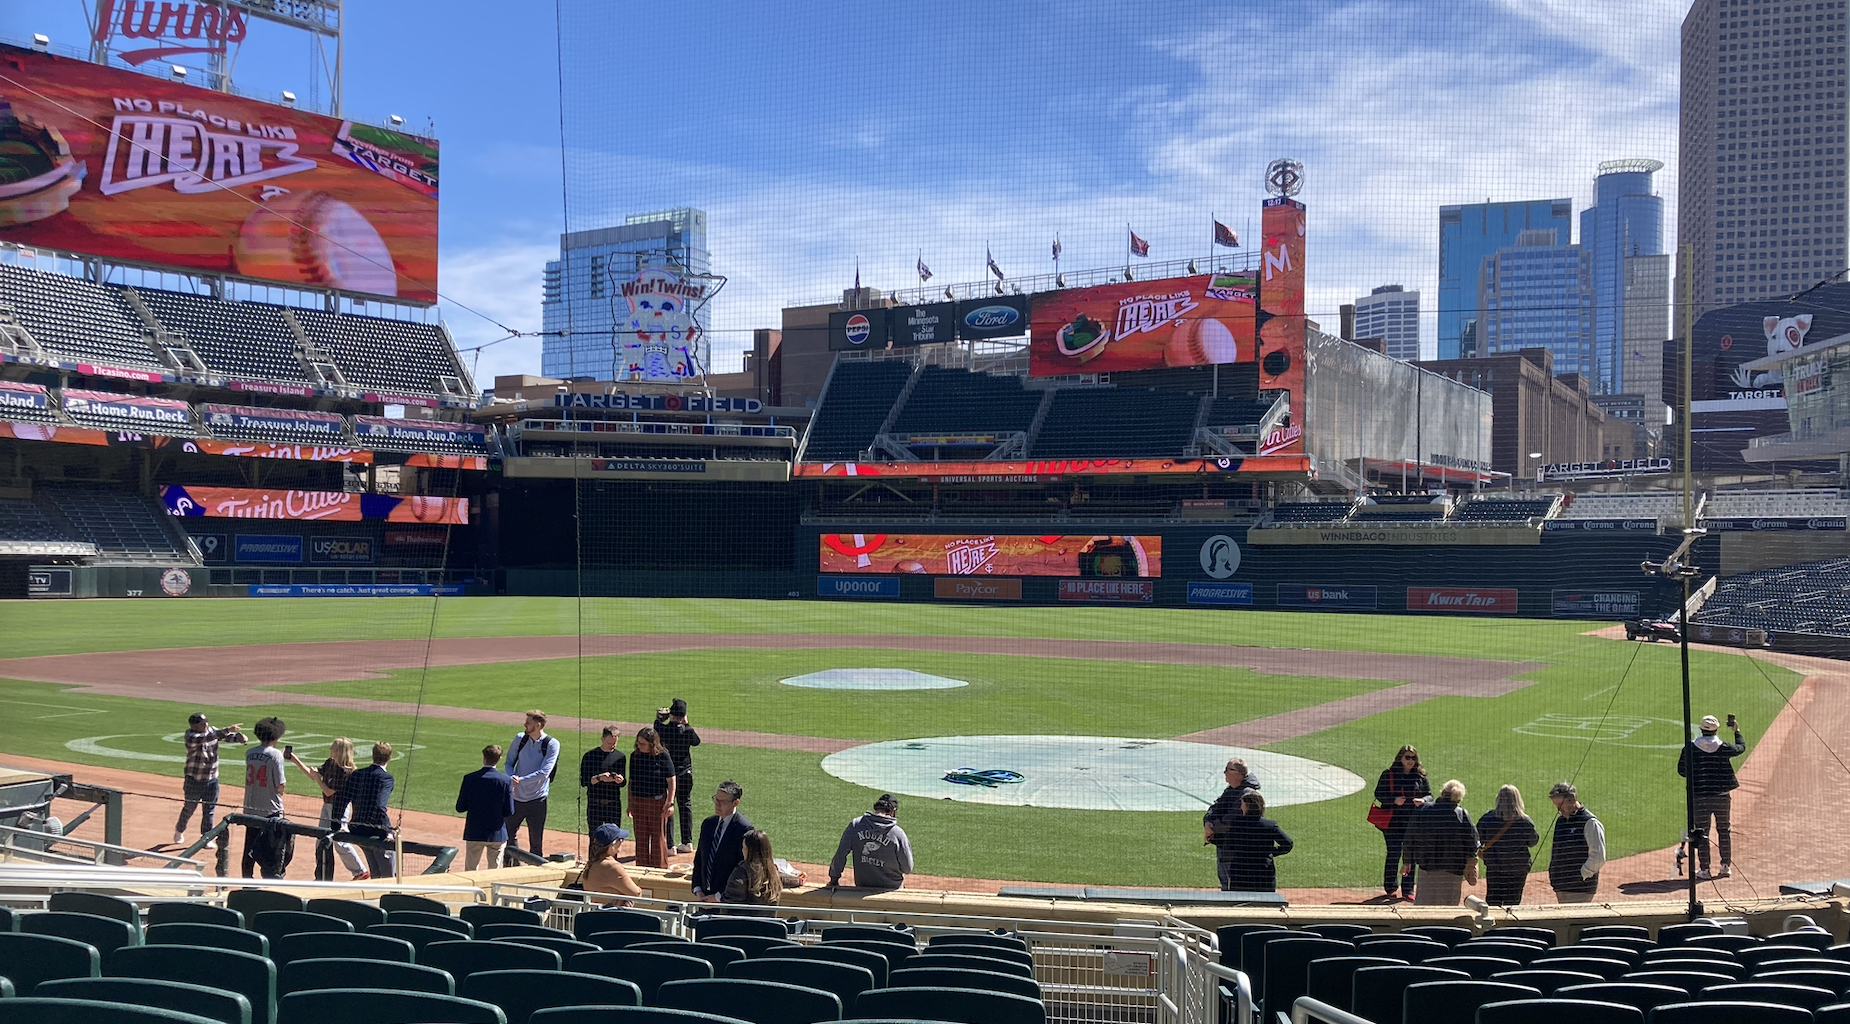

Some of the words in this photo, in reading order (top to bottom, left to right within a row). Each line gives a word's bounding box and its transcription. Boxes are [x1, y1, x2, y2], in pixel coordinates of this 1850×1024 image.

[113, 97, 153, 113] NO
[158, 100, 242, 132] PLACE
[247, 122, 298, 139] LIKE
[126, 121, 263, 181] HERE
[350, 142, 437, 186] TARGET
[1264, 243, 1293, 281] M
[621, 279, 656, 298] Win!
[656, 278, 706, 299] Twins!
[1213, 288, 1256, 299] TARGET
[1119, 296, 1132, 306] NO
[1169, 290, 1191, 300] LIKE
[915, 308, 926, 318] The
[974, 311, 1008, 326] Ford
[907, 316, 939, 326] Minnesota
[846, 325, 869, 333] PEPSI
[921, 325, 935, 333] Star
[912, 332, 935, 341] Tribune
[240, 382, 278, 393] Treasure
[279, 385, 305, 395] Island
[1728, 389, 1780, 400] TARGET
[556, 392, 661, 409] TARGET
[687, 396, 763, 413] FIELD
[92, 403, 127, 418] Home
[130, 407, 153, 420] Run
[156, 408, 184, 423] Deck
[240, 416, 292, 430] Treasure
[295, 420, 330, 433] Island
[393, 427, 424, 439] Home
[426, 430, 446, 441] Run
[448, 432, 474, 442] Deck
[1540, 461, 1601, 473] TARGET
[1621, 457, 1671, 470] FIELD
[217, 494, 285, 520] Twin
[285, 490, 351, 518] Cities
[1545, 520, 1575, 531] Corona
[1583, 520, 1615, 531] Corona
[1622, 520, 1655, 531] Corona
[1700, 519, 1734, 529] Corona
[1752, 519, 1788, 530] Corona
[1807, 518, 1845, 530] Corona
[406, 535, 442, 544] Budweiser
[945, 541, 955, 549] NO
[980, 535, 995, 544] LIKE
[1320, 532, 1386, 541] WINNEBAGO
[1387, 532, 1457, 541] INDUSTRIES
[240, 543, 299, 553] PROGRESSIVE
[952, 548, 985, 574] HERE
[300, 586, 326, 594] There's
[336, 586, 355, 594] catch.
[356, 586, 371, 594] Just
[371, 587, 389, 595] great
[835, 580, 881, 593] uponor
[956, 582, 999, 596] Paycor
[1077, 582, 1105, 594] PLACE
[1106, 583, 1119, 594] LIKE
[1121, 583, 1144, 595] HERE
[1190, 588, 1249, 599] PROGRESSIVE
[1593, 593, 1637, 603] CHANGING
[1595, 603, 1611, 612] THE
[1612, 603, 1636, 613] GAME
[246, 764, 268, 788] 34
